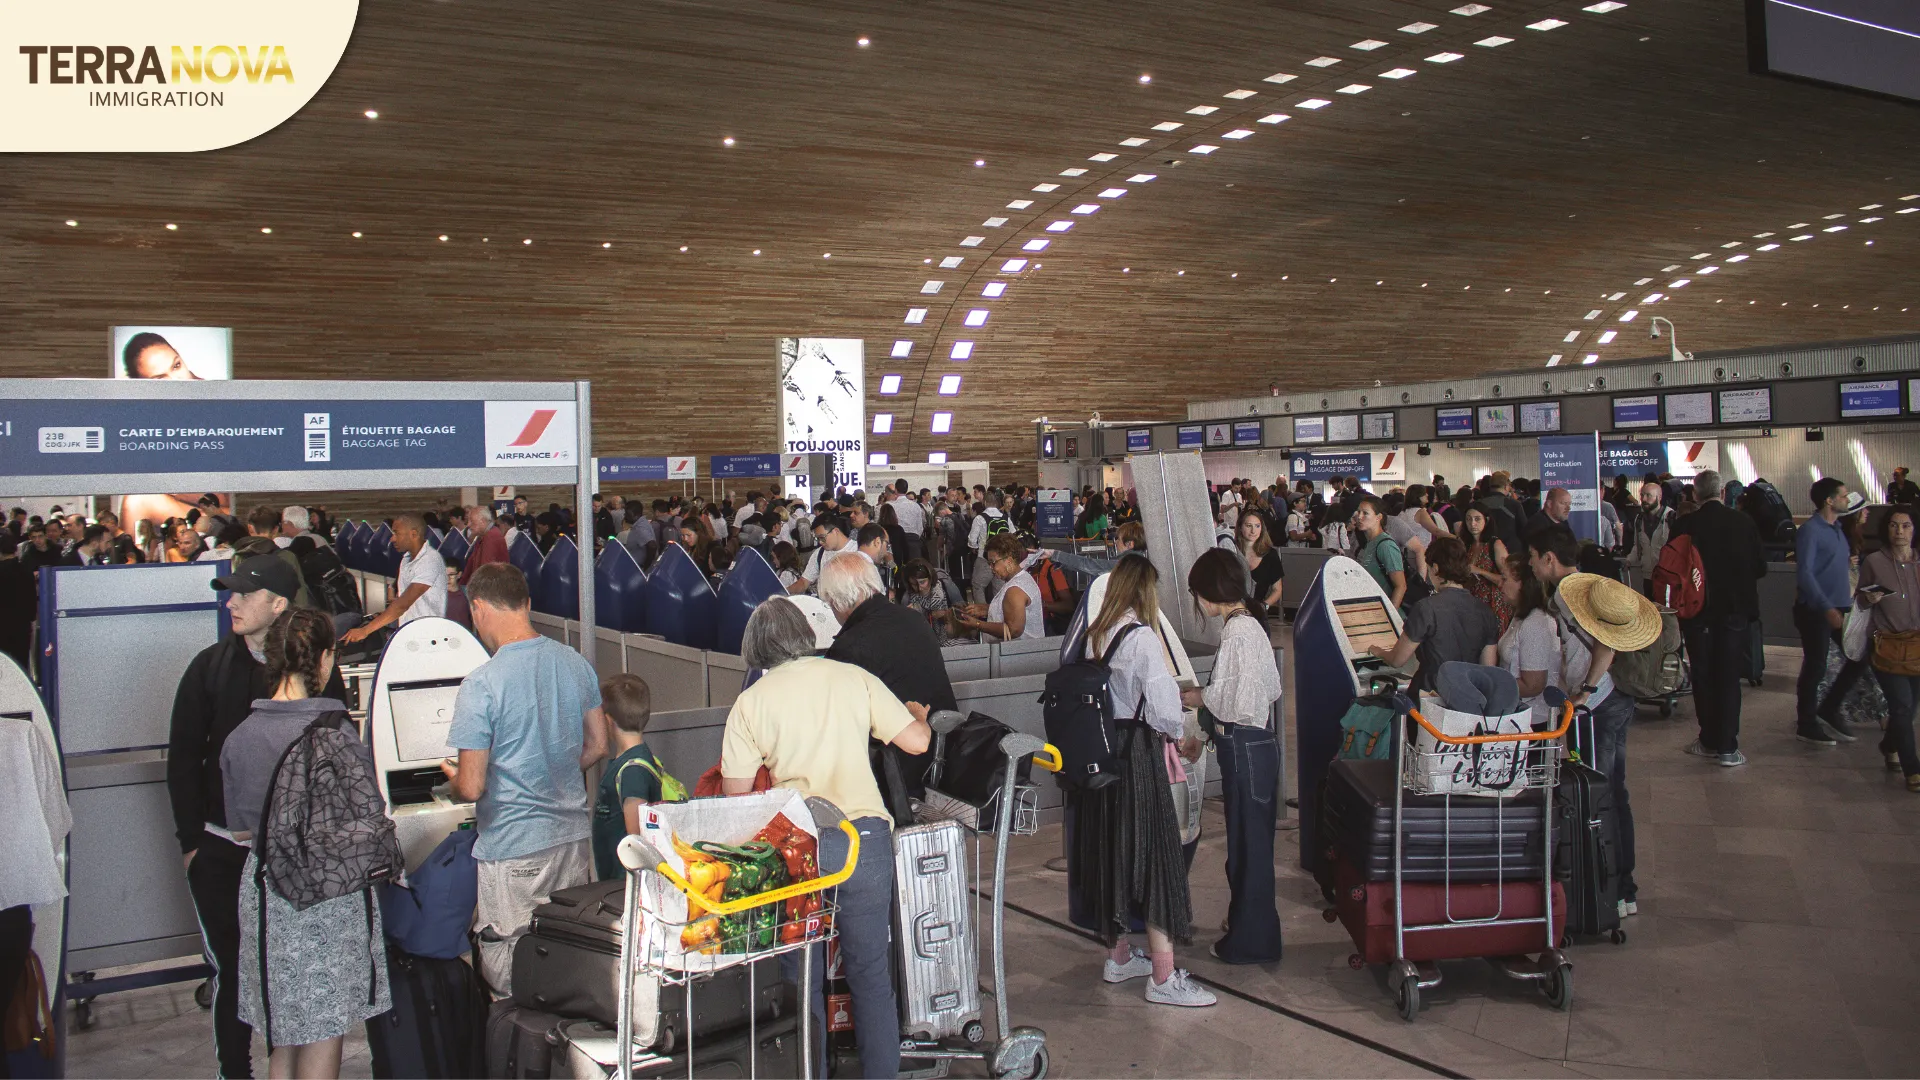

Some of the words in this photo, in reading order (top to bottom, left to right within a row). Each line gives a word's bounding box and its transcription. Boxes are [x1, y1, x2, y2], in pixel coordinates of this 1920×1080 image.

[309, 416, 325, 425] AF
[119, 428, 163, 438] CARTE
[342, 425, 404, 435] ÉTIQUETTE
[407, 426, 456, 435] BAGAGE
[45, 432, 64, 440] 23B
[119, 441, 189, 451] BOARDING
[193, 441, 225, 450] PASS
[342, 439, 400, 448] BAGGAGE
[403, 438, 427, 447] TAG
[788, 440, 861, 452] TOUJOURS
[1045, 439, 1052, 454] 4
[309, 450, 326, 459] JFK
[1610, 449, 1648, 458] BAGAGES
[1544, 460, 1582, 468] destination
[1619, 458, 1659, 467] DROP-OFF
[1337, 465, 1365, 473] DROP-OFF
